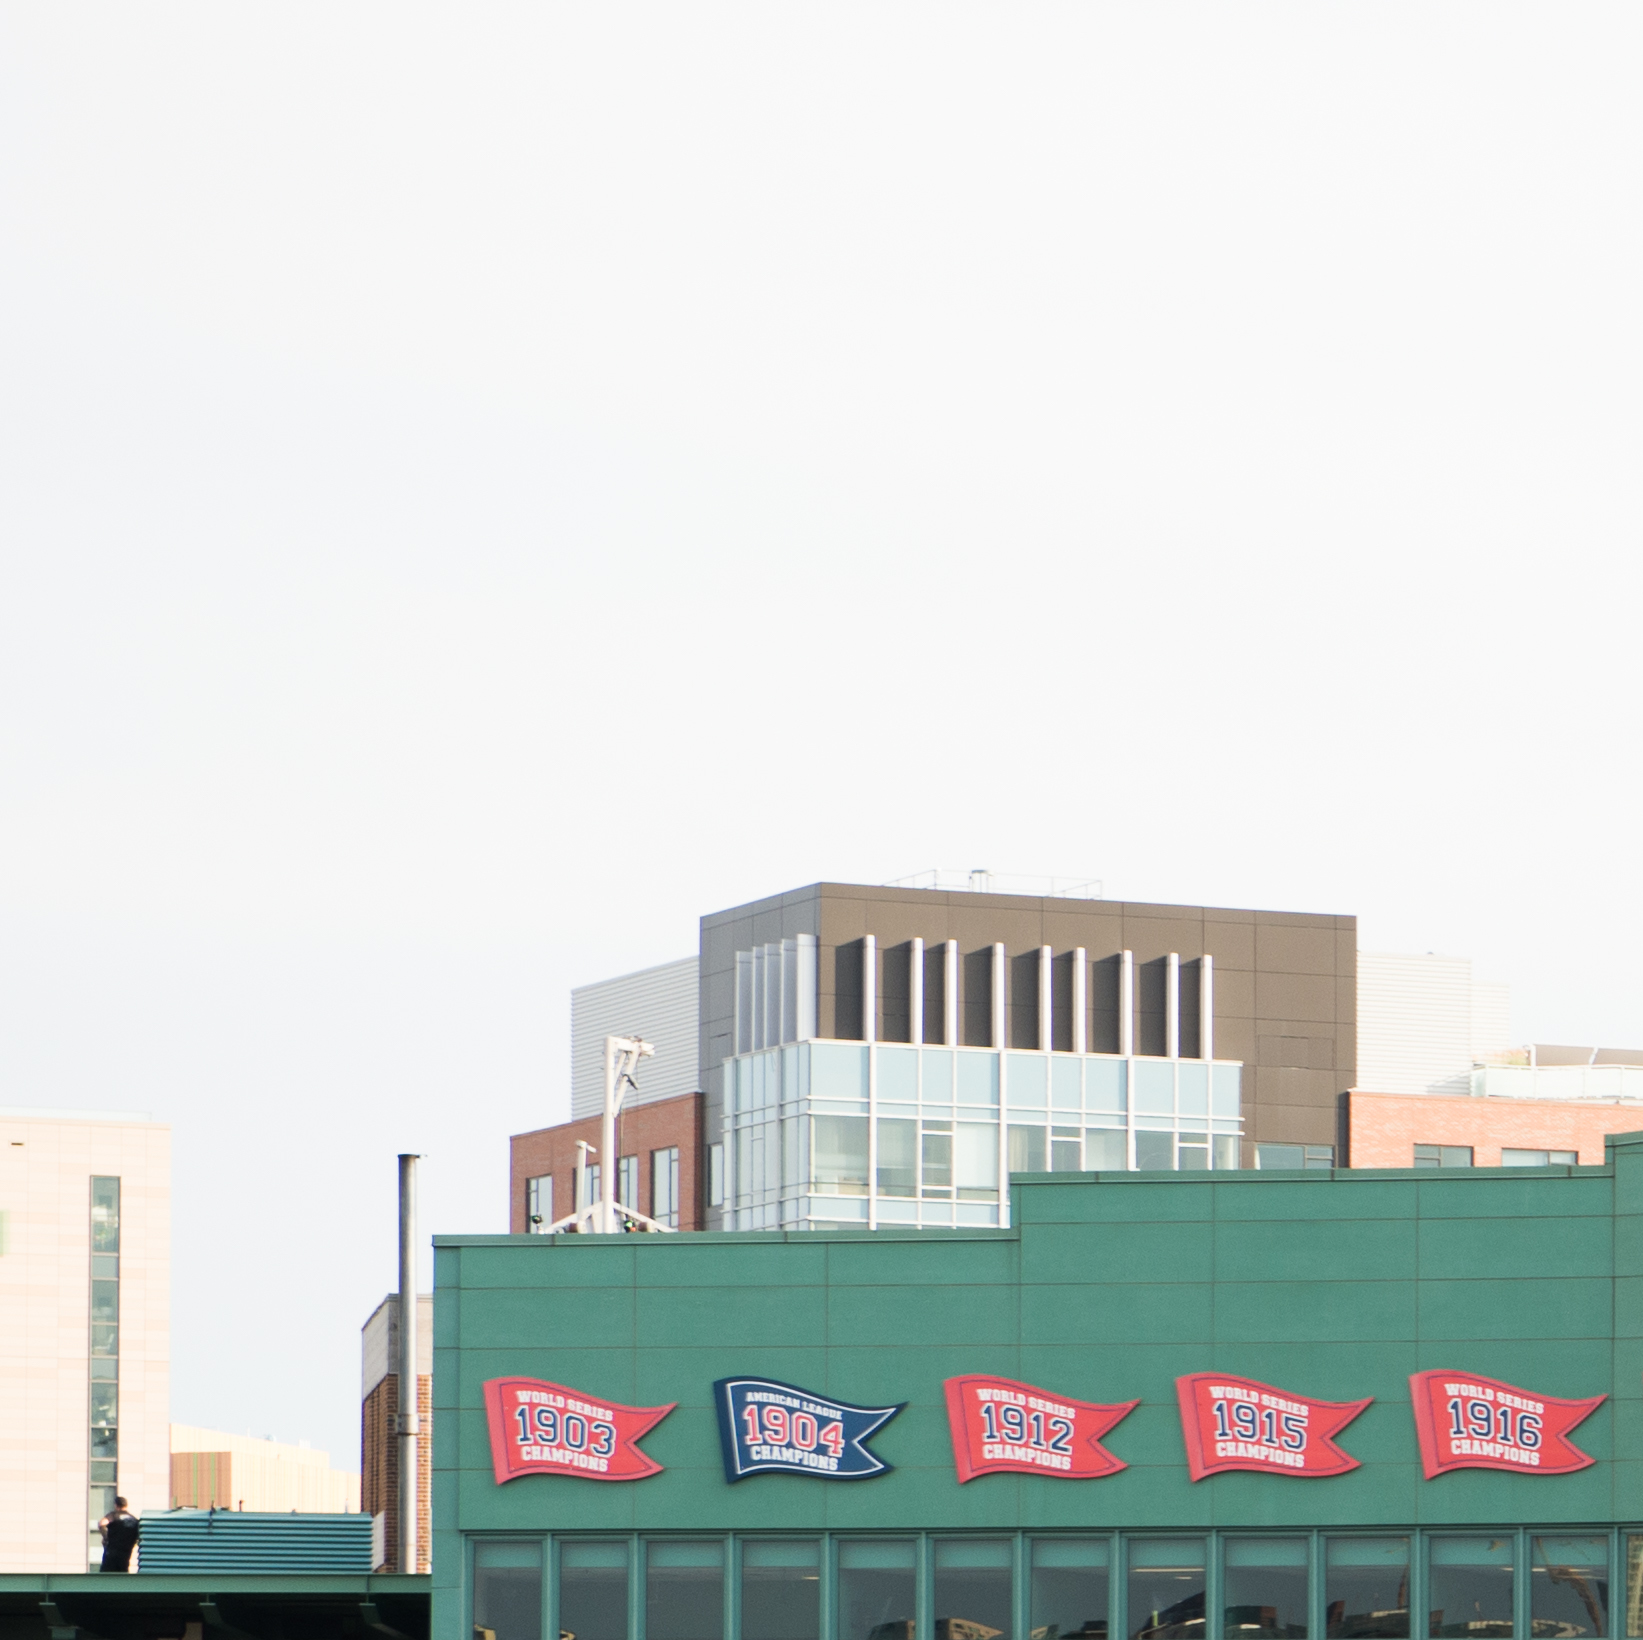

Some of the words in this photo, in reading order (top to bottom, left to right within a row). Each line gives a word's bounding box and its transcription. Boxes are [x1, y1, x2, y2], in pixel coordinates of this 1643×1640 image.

[516, 1390, 565, 1408] WORLD
[567, 1397, 613, 1422] SERIES
[745, 1391, 802, 1413] AMERICAN
[803, 1401, 843, 1421] LEAGUE
[976, 1388, 1026, 1405] WORLD
[1027, 1396, 1076, 1419] SERIES
[1209, 1386, 1259, 1403] WORLD
[1260, 1393, 1309, 1417] SERIES
[1443, 1383, 1495, 1401] WORLD
[1496, 1391, 1545, 1414] SERIES
[515, 1404, 617, 1458] 1903
[742, 1404, 845, 1457] 1904
[980, 1403, 1075, 1455] 1912
[1212, 1401, 1308, 1453] 1915
[1447, 1398, 1543, 1450] 1916
[521, 1445, 609, 1471] CHAMPIONS
[750, 1445, 839, 1470] CHAMPIONS
[982, 1443, 1072, 1470] CHAMPIONS
[1215, 1441, 1305, 1468] CHAMPIONS
[1450, 1438, 1540, 1466] CHAMPIONS
